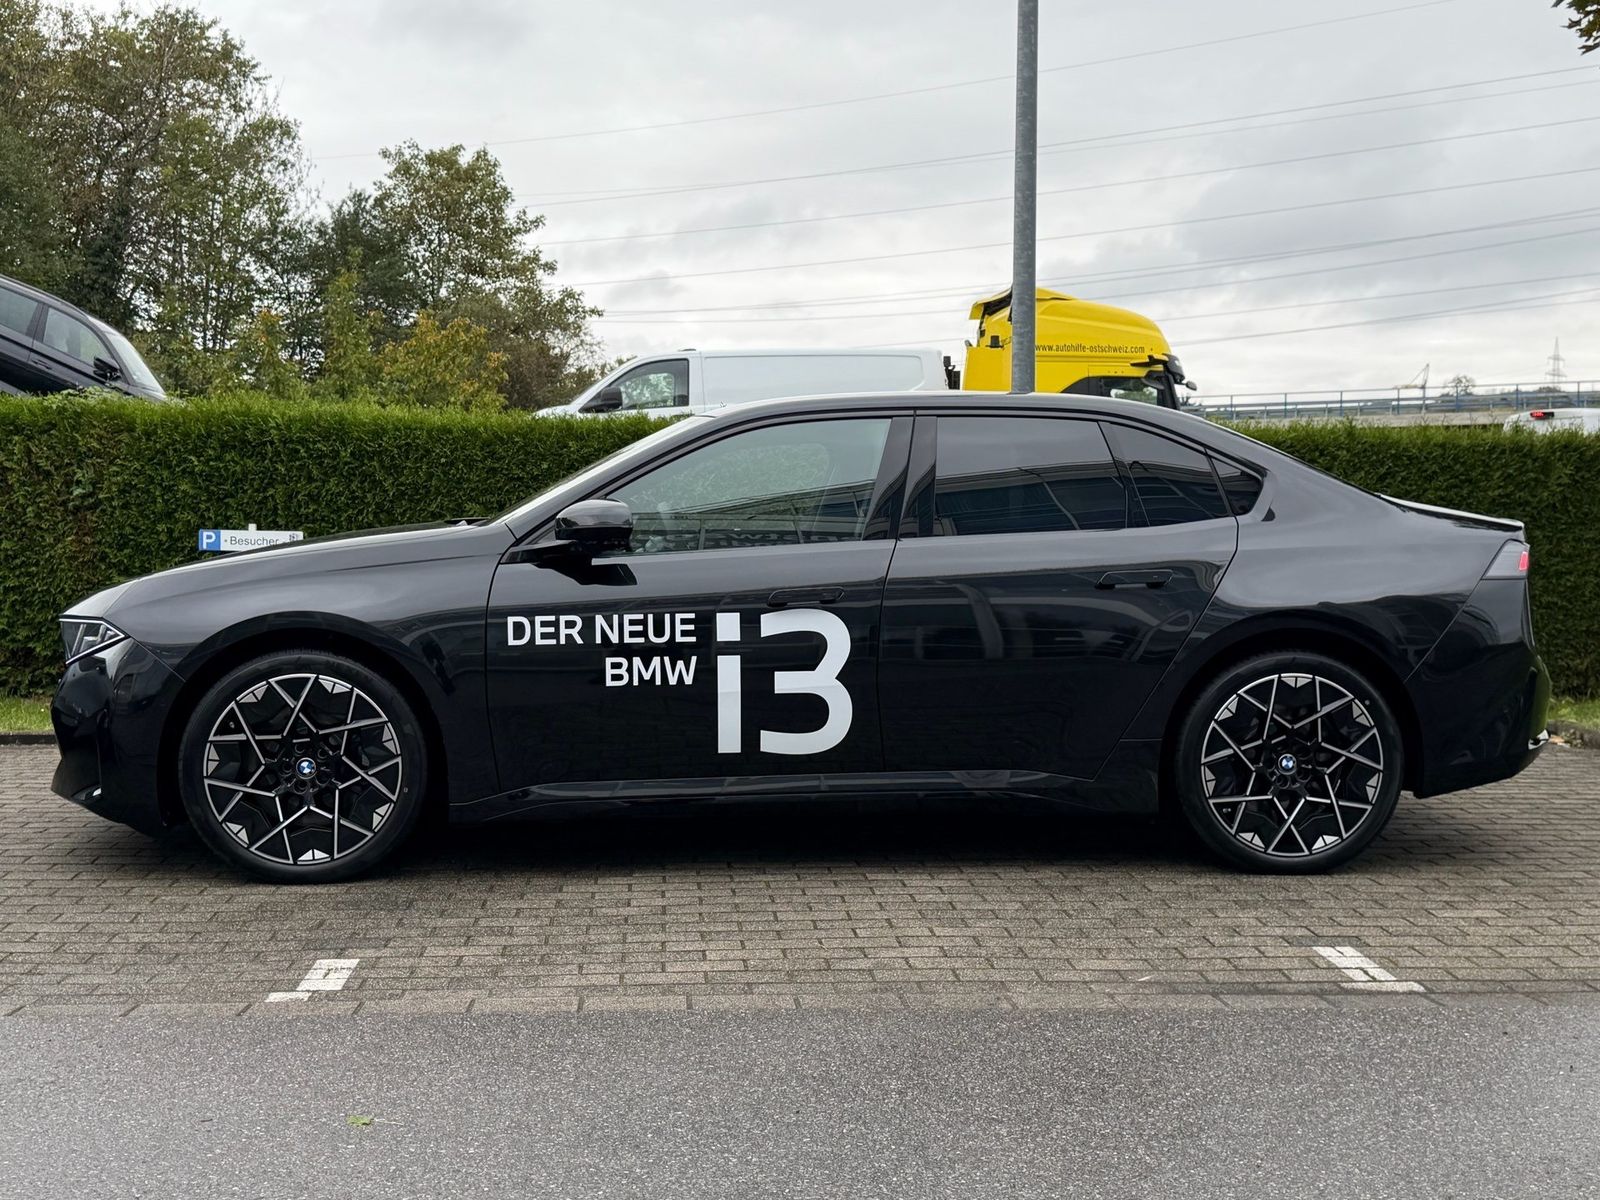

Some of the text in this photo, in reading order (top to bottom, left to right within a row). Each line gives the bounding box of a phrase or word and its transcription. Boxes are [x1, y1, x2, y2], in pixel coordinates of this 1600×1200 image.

[1035, 343, 1145, 354] www.autohilfe-ostschweiz.com
[202, 531, 279, 549] P Besucher
[506, 613, 697, 646] DER NEUE
[605, 656, 697, 687] BMW
[716, 608, 853, 755] i3
